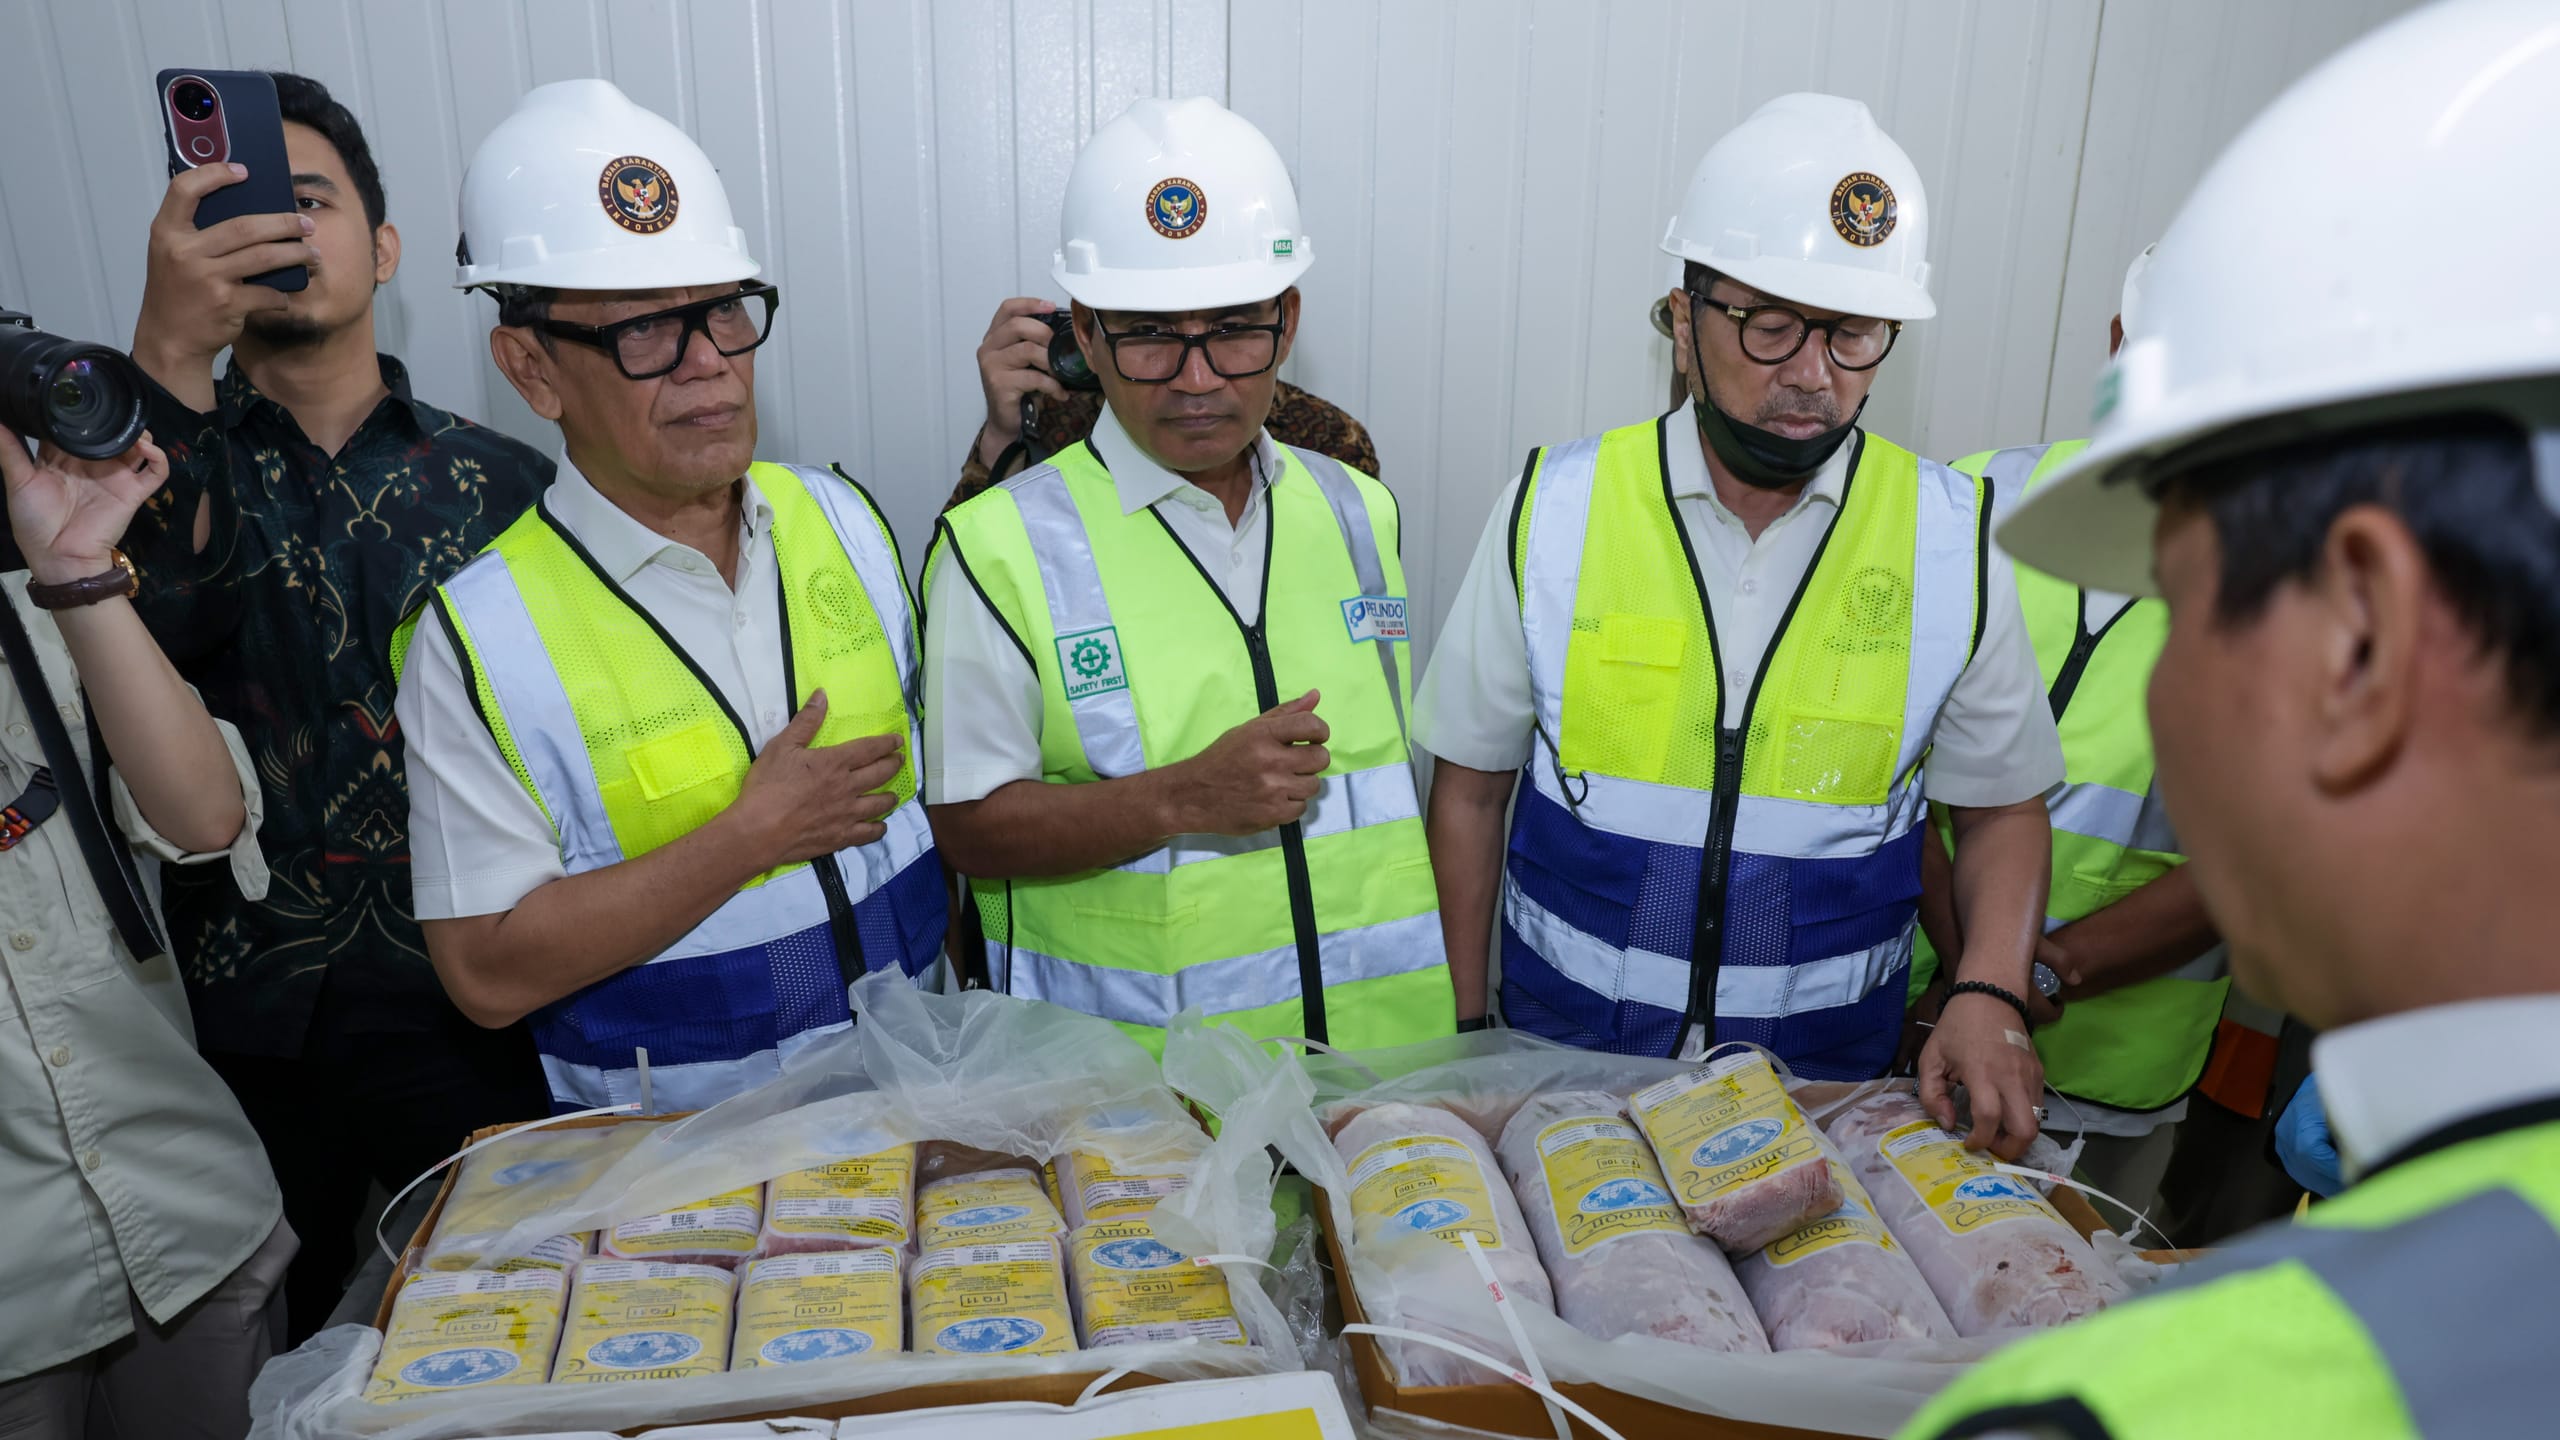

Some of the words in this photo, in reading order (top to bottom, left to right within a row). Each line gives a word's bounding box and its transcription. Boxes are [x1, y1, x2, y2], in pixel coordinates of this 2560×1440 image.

[601, 161, 621, 189] BADAN
[622, 157, 671, 186] KARANTINA
[1149, 183, 1167, 204] BADAN
[1167, 178, 1204, 202] KARANTINA
[1835, 174, 1859, 197] BADAN
[1860, 174, 1895, 207] KARANTINA
[606, 199, 679, 233] INDONESIA
[1149, 211, 1206, 239] INDONESIA
[1832, 211, 1896, 245] INDONESIA
[1275, 240, 1292, 251] MSA
[1365, 601, 1404, 619] PELINDO
[1069, 680, 1099, 695] SAFETY
[1101, 675, 1122, 688] FIRST
[832, 1166, 850, 1174] FQ
[852, 1166, 865, 1174] 11
[1708, 1145, 1790, 1187] Amroon
[1133, 1284, 1152, 1293] FQ
[1154, 1282, 1168, 1291] 11
[817, 1304, 836, 1314] FQ
[966, 1296, 979, 1304] 11
[982, 1295, 1001, 1304] FQ
[800, 1306, 813, 1315] 11
